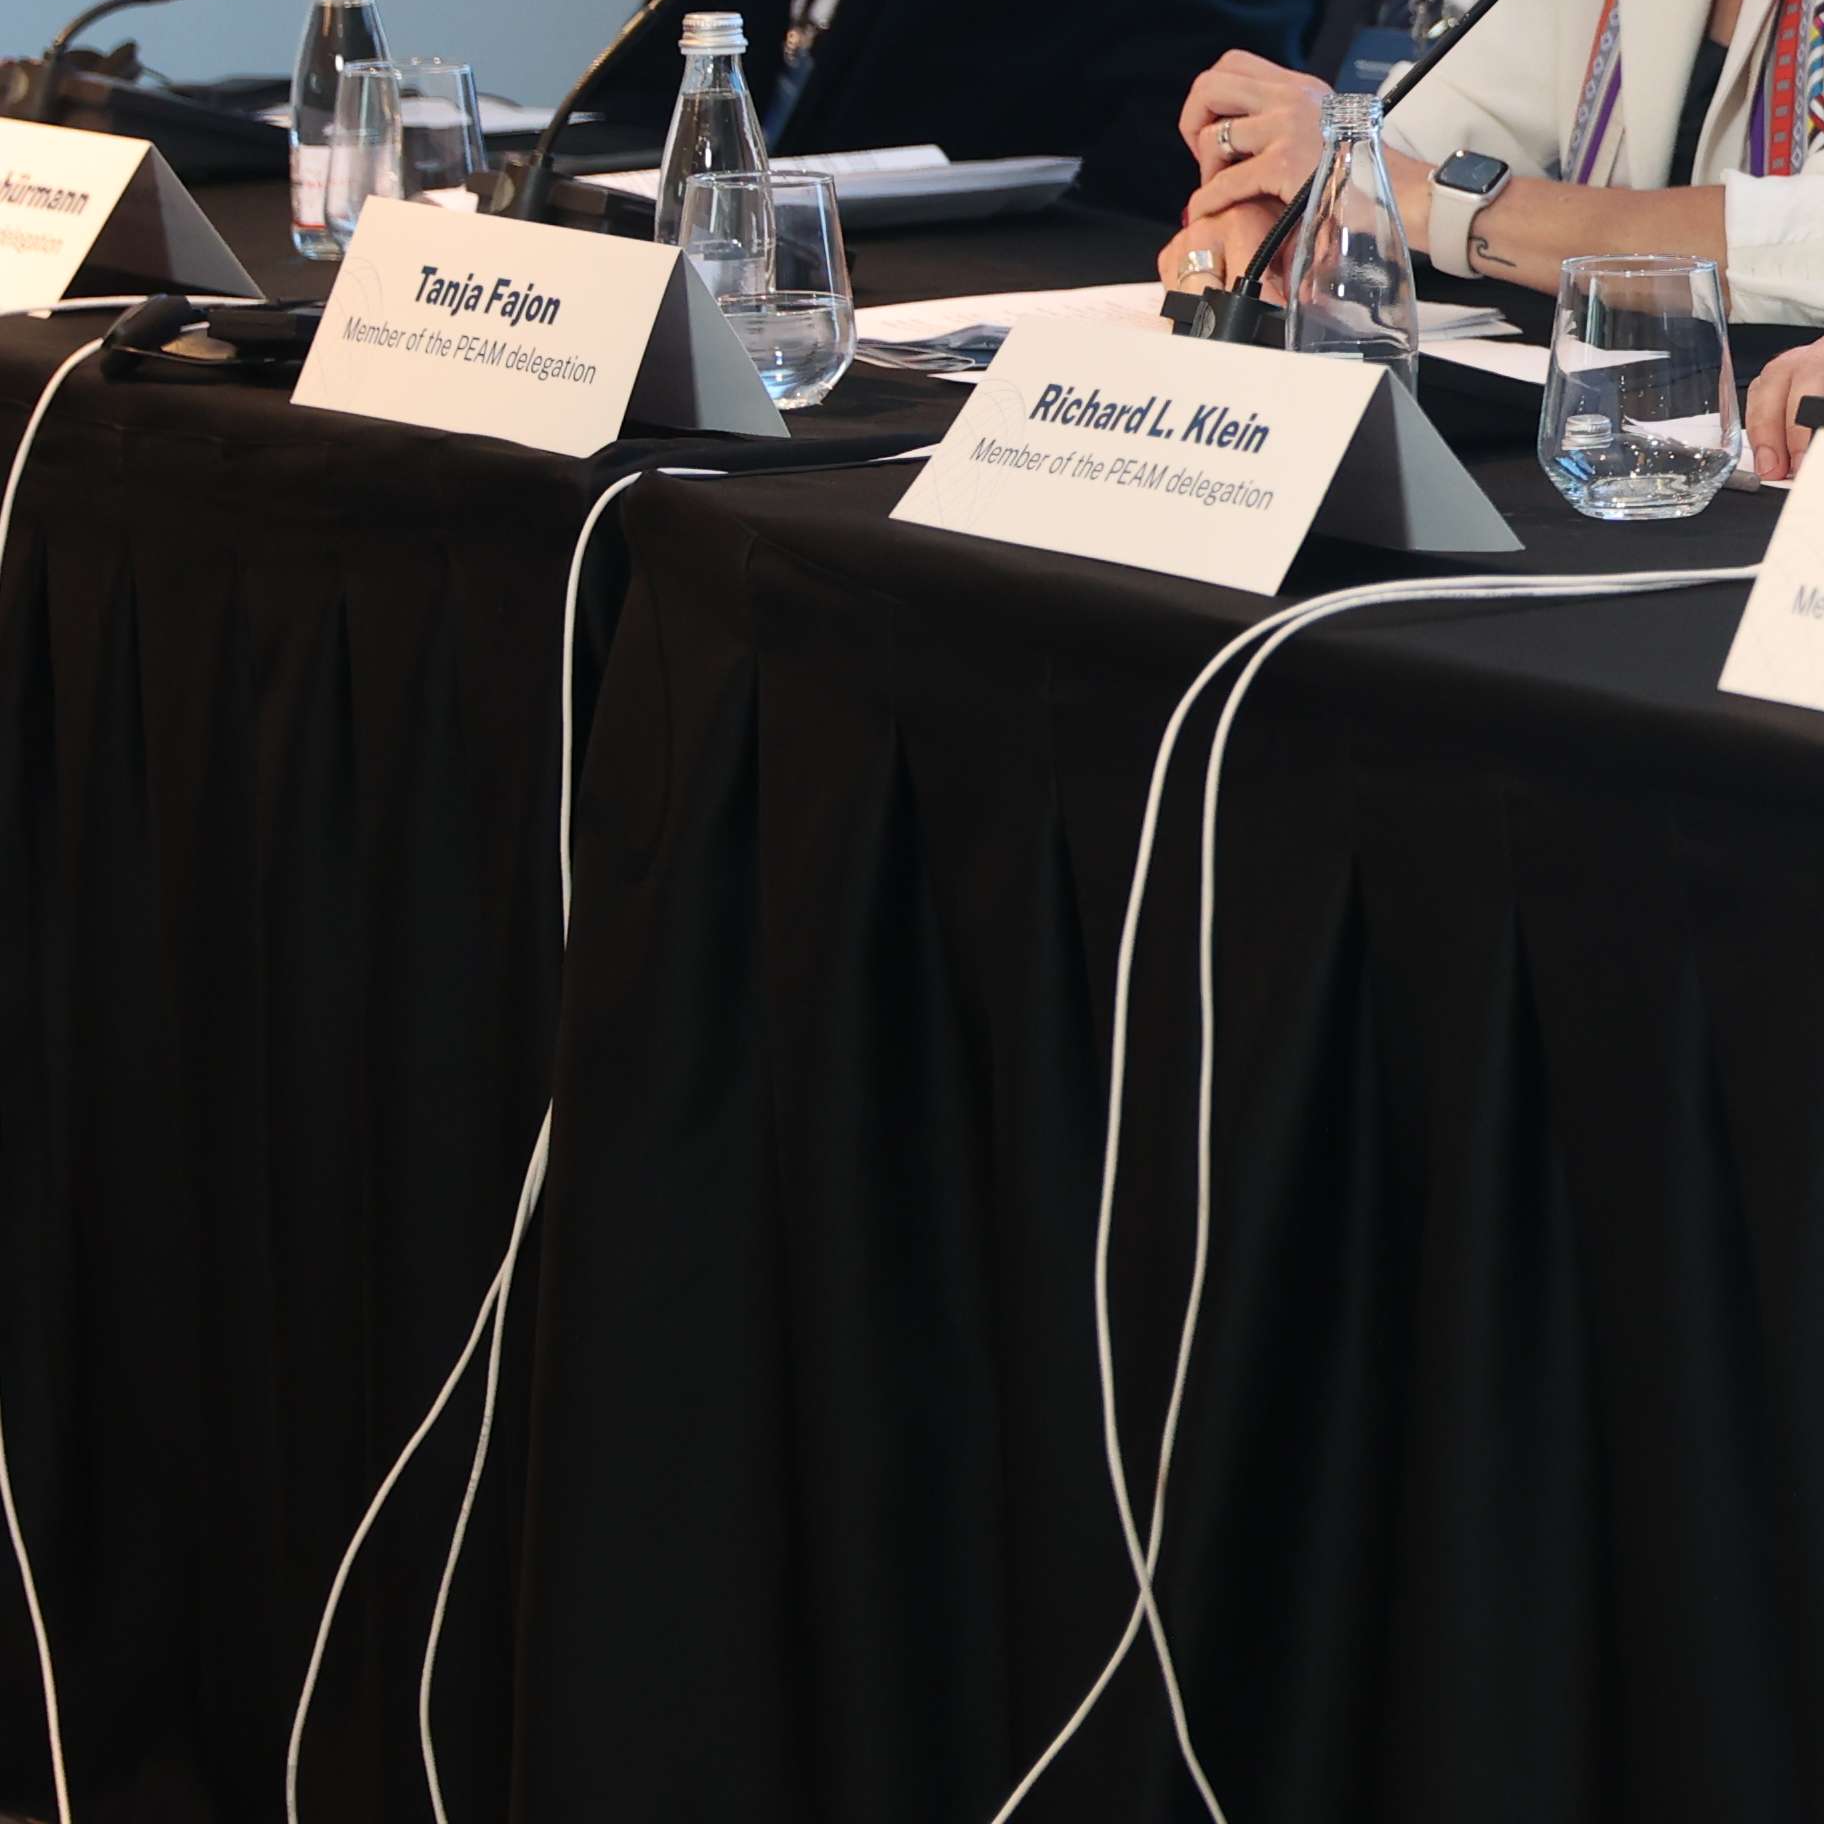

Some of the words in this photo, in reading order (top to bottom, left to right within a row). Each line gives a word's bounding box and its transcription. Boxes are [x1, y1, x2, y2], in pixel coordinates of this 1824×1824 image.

[414, 265, 484, 316] Tanja
[484, 277, 561, 327] Fajon
[342, 316, 405, 348] Member
[406, 328, 427, 351] of
[428, 330, 452, 357] the
[453, 334, 507, 366] PEAM
[505, 344, 597, 384] delegation
[1029, 383, 1157, 435] Richard
[1147, 398, 1175, 439] L.
[1181, 404, 1270, 454] Klein
[970, 437, 1050, 472] Member
[1048, 451, 1076, 475] of
[1072, 453, 1105, 480] the
[1105, 457, 1168, 491] PEAM
[1166, 468, 1275, 511] delegation
